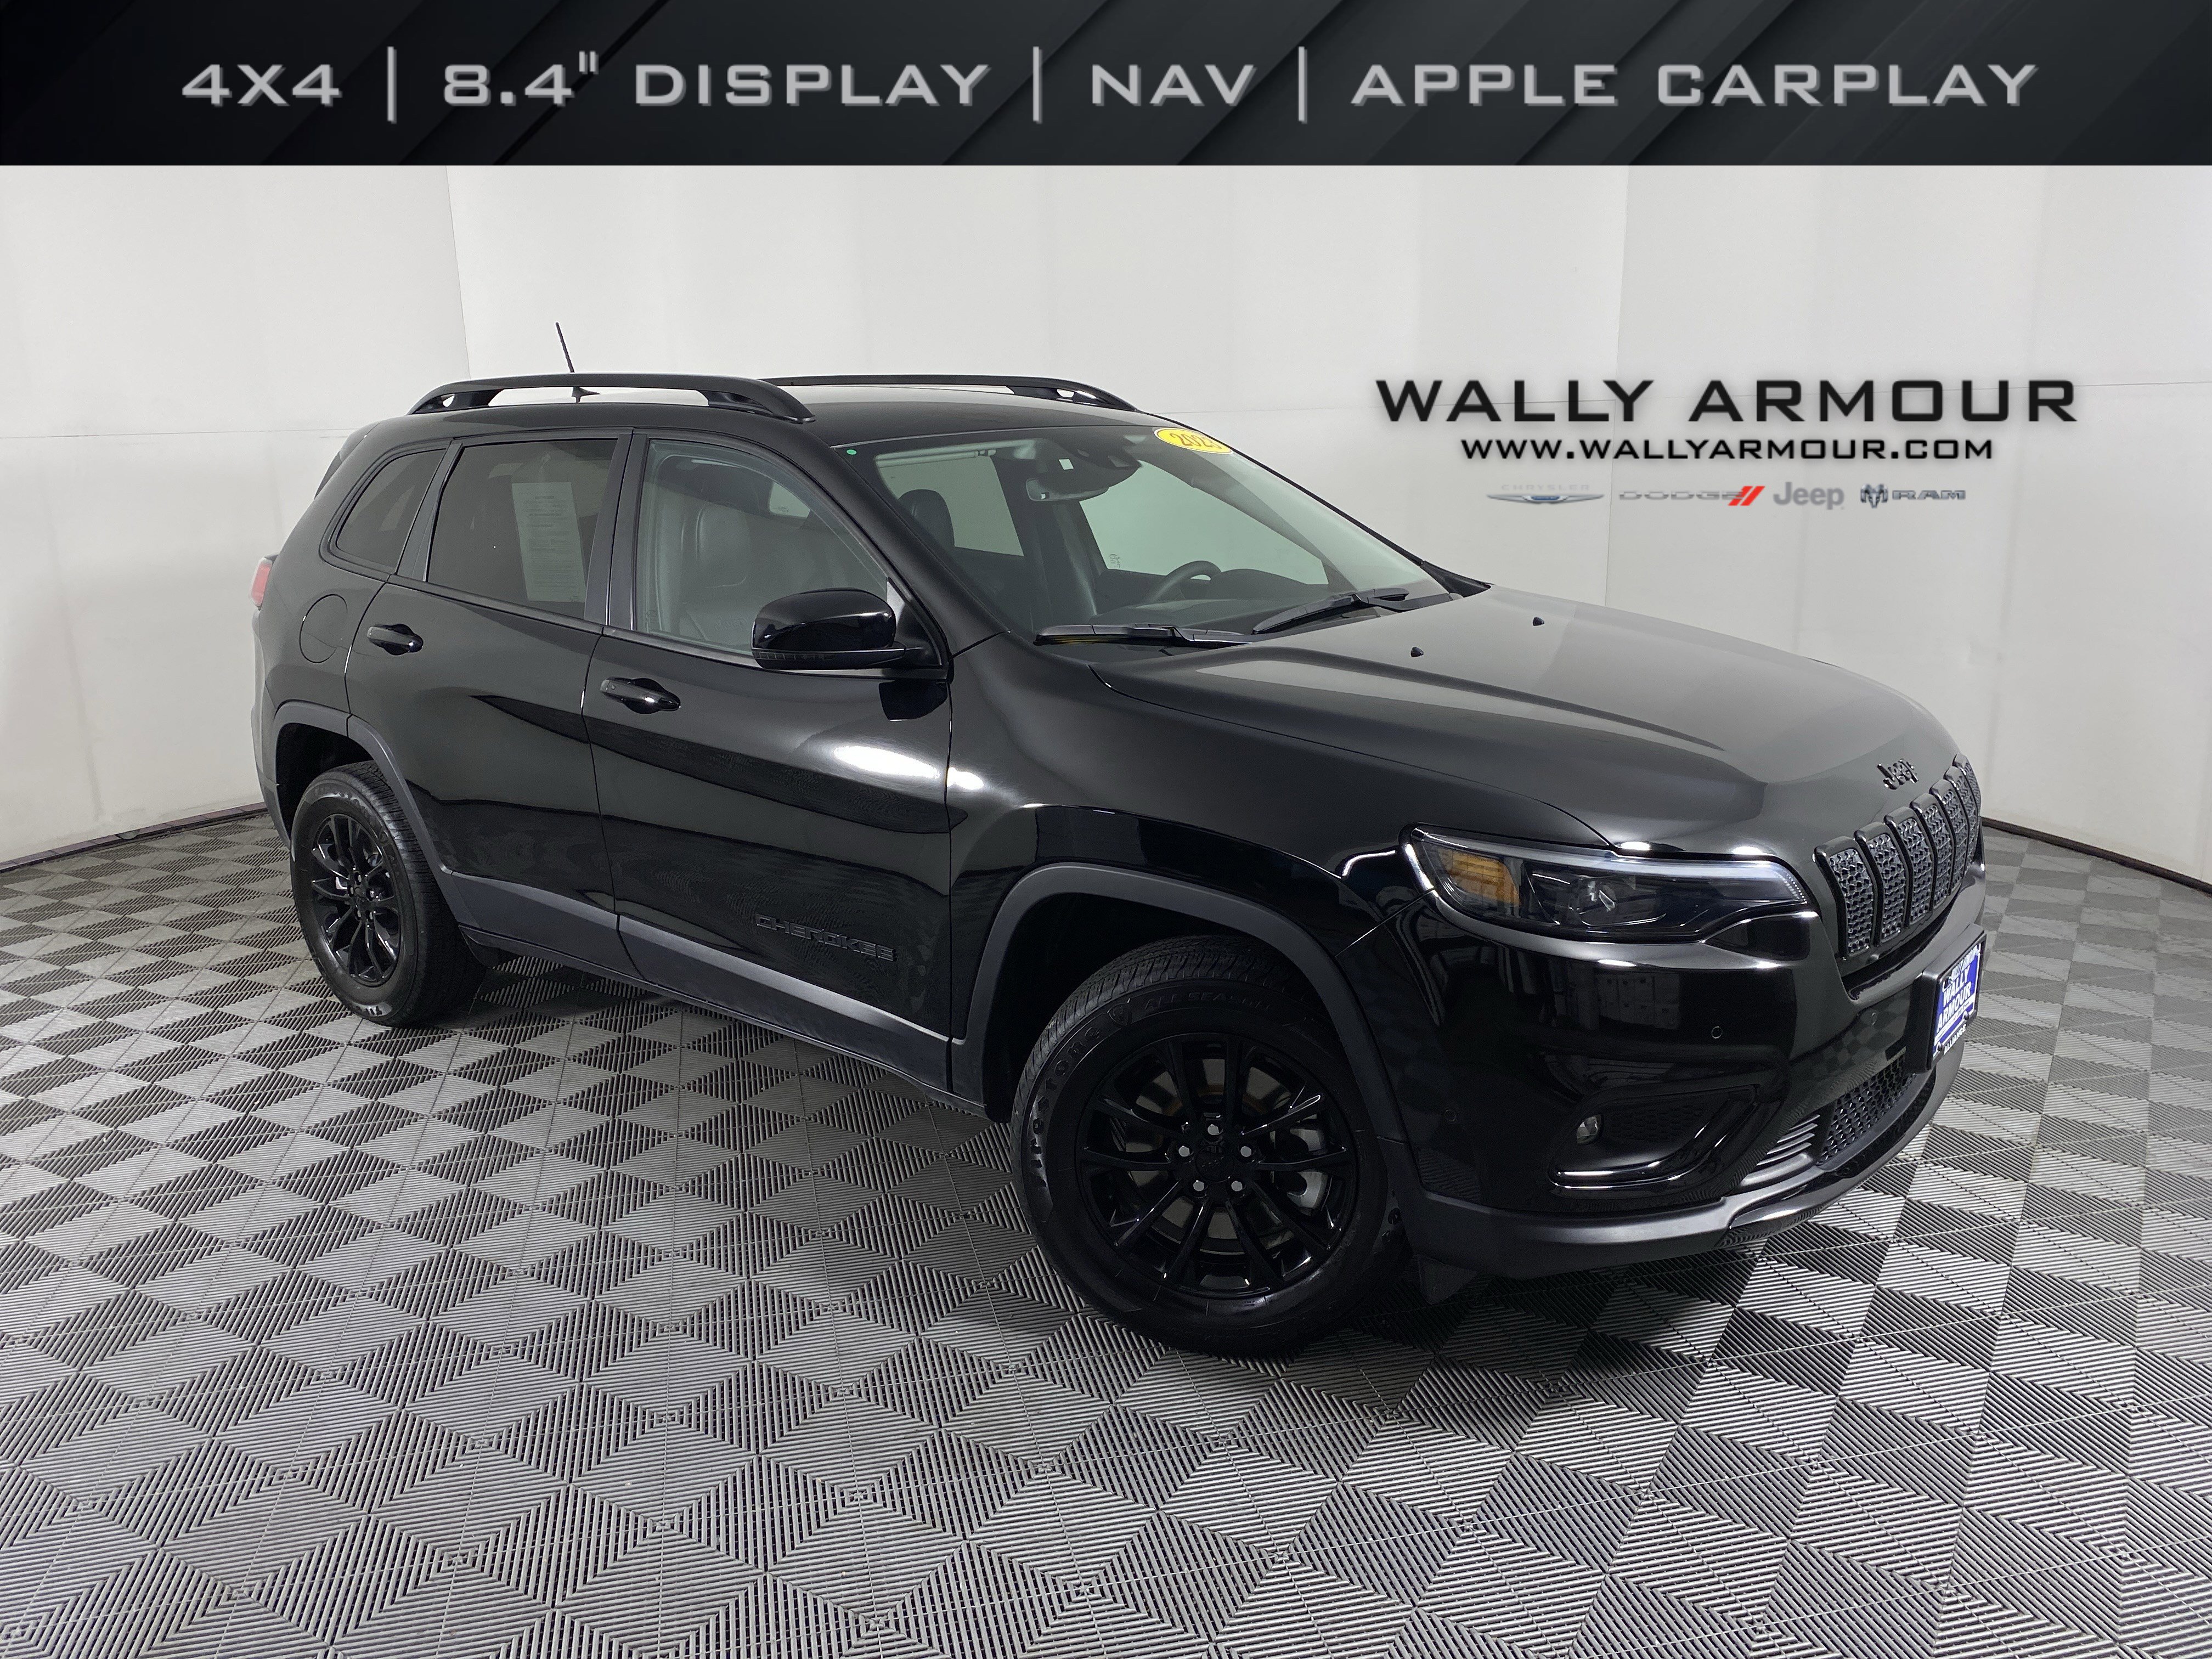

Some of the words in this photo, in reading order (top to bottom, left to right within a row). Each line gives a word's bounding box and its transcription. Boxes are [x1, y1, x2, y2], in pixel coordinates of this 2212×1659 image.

[1877, 758, 1919, 790] Jeep
[755, 913, 898, 962] CHEROKEE
[1937, 981, 1972, 1033] ARMOUR
[1943, 964, 1971, 1008] WALLY
